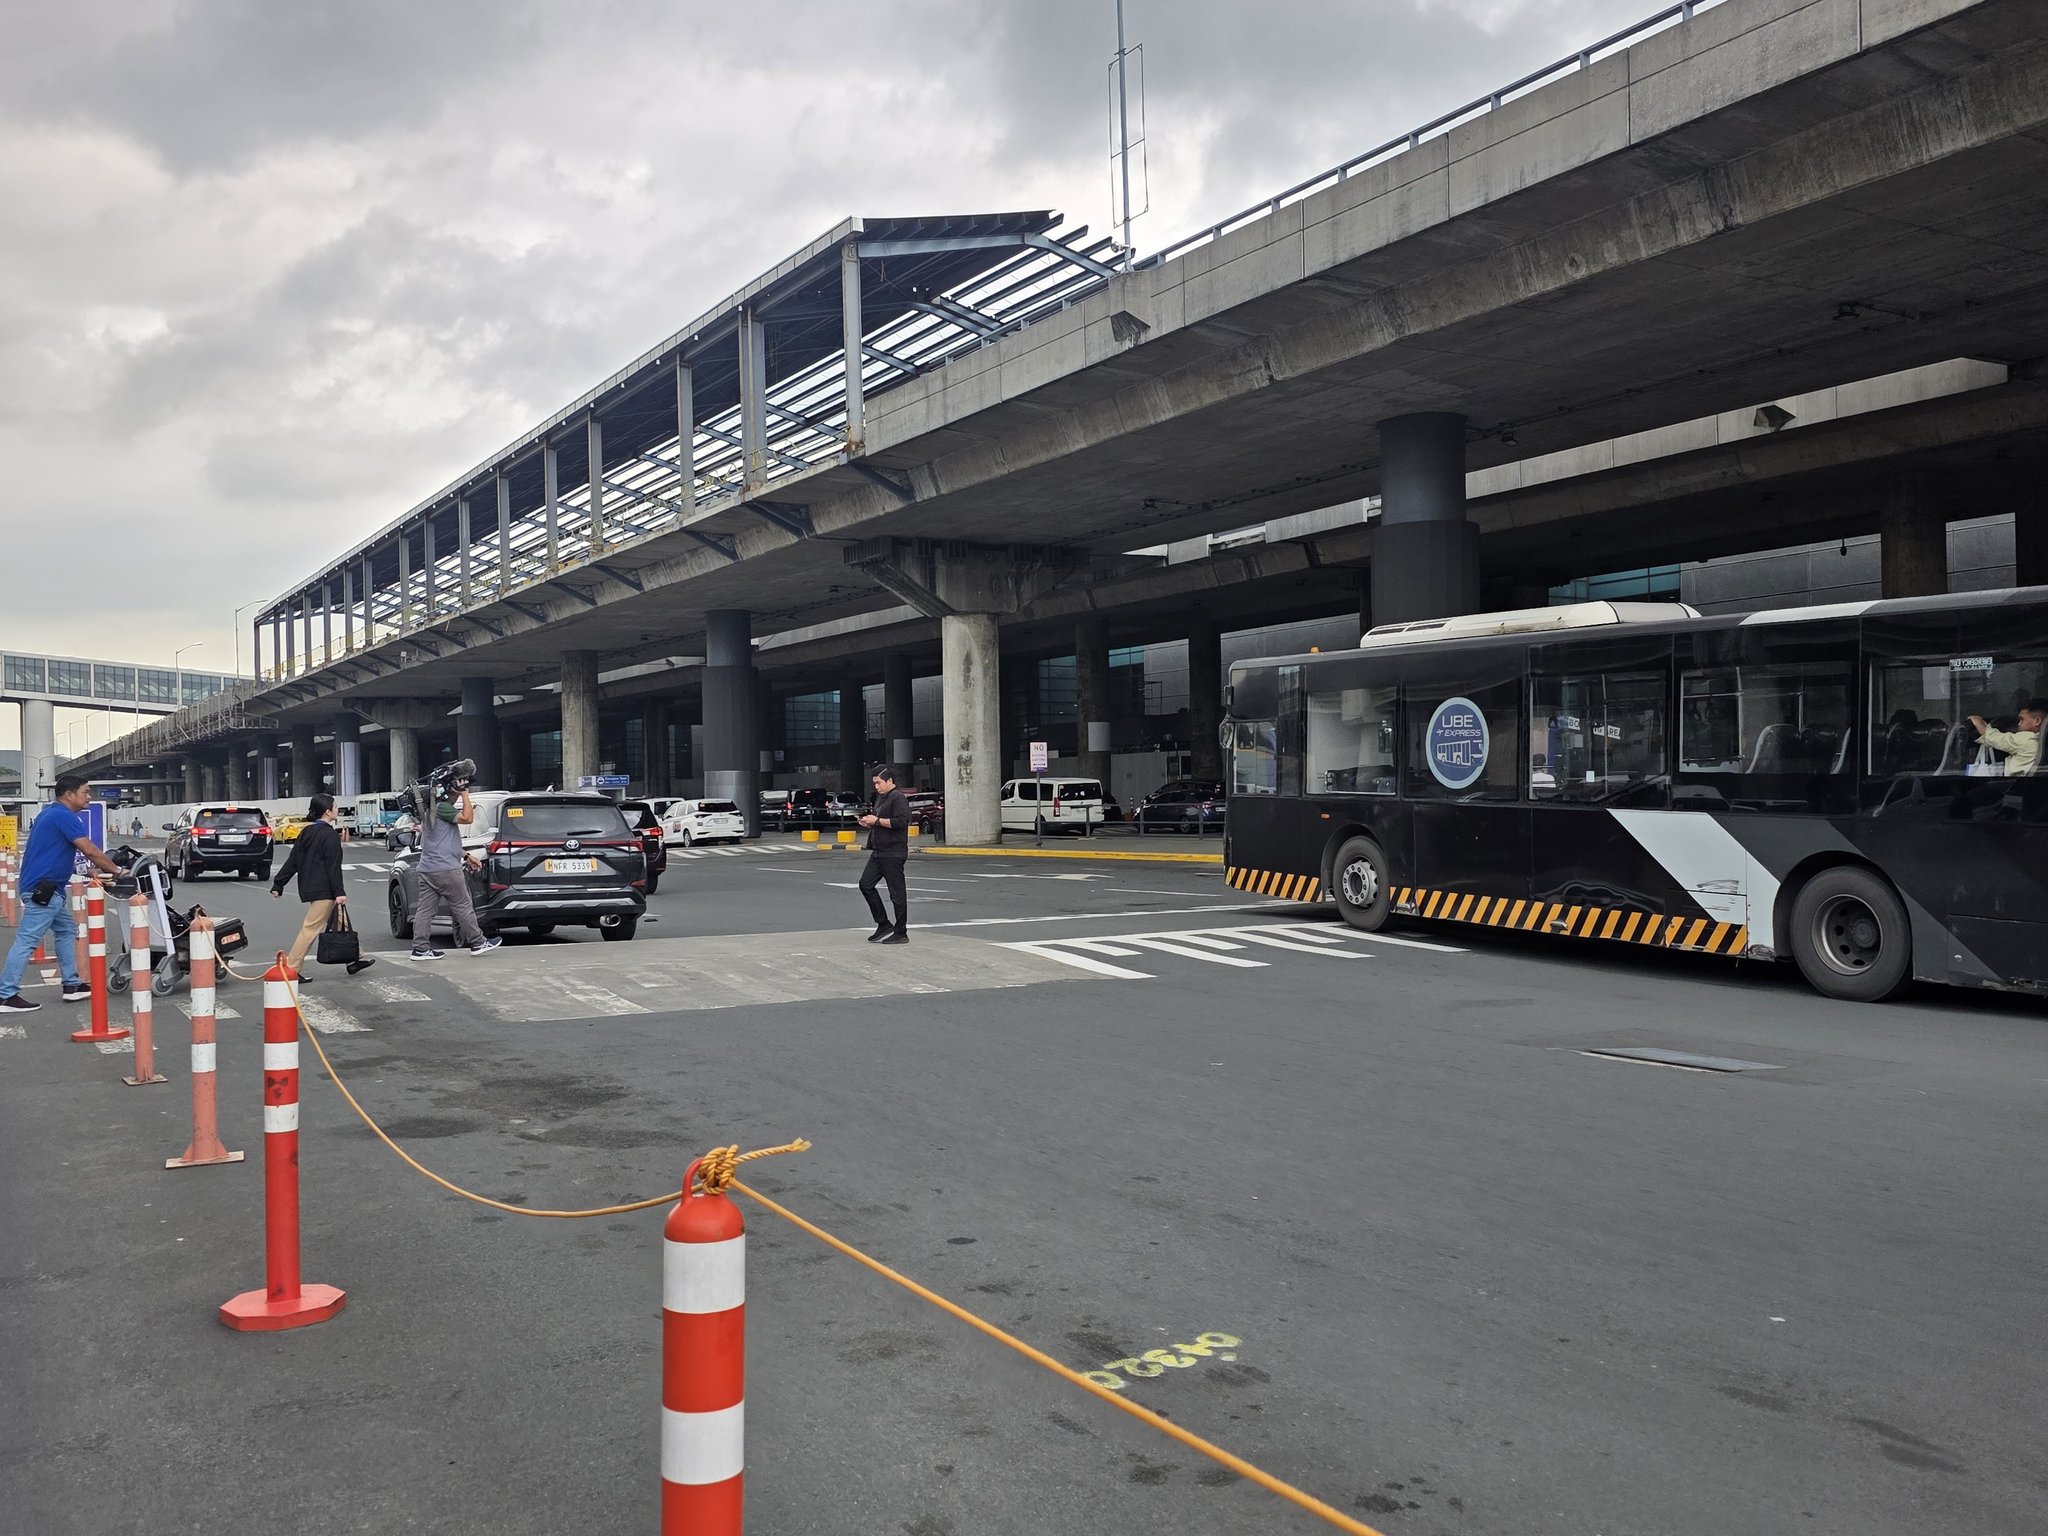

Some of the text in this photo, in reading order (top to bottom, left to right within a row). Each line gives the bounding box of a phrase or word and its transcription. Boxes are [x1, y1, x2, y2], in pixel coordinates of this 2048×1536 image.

[1442, 714, 1473, 728] UBE
[553, 862, 590, 870] NFR 5339
